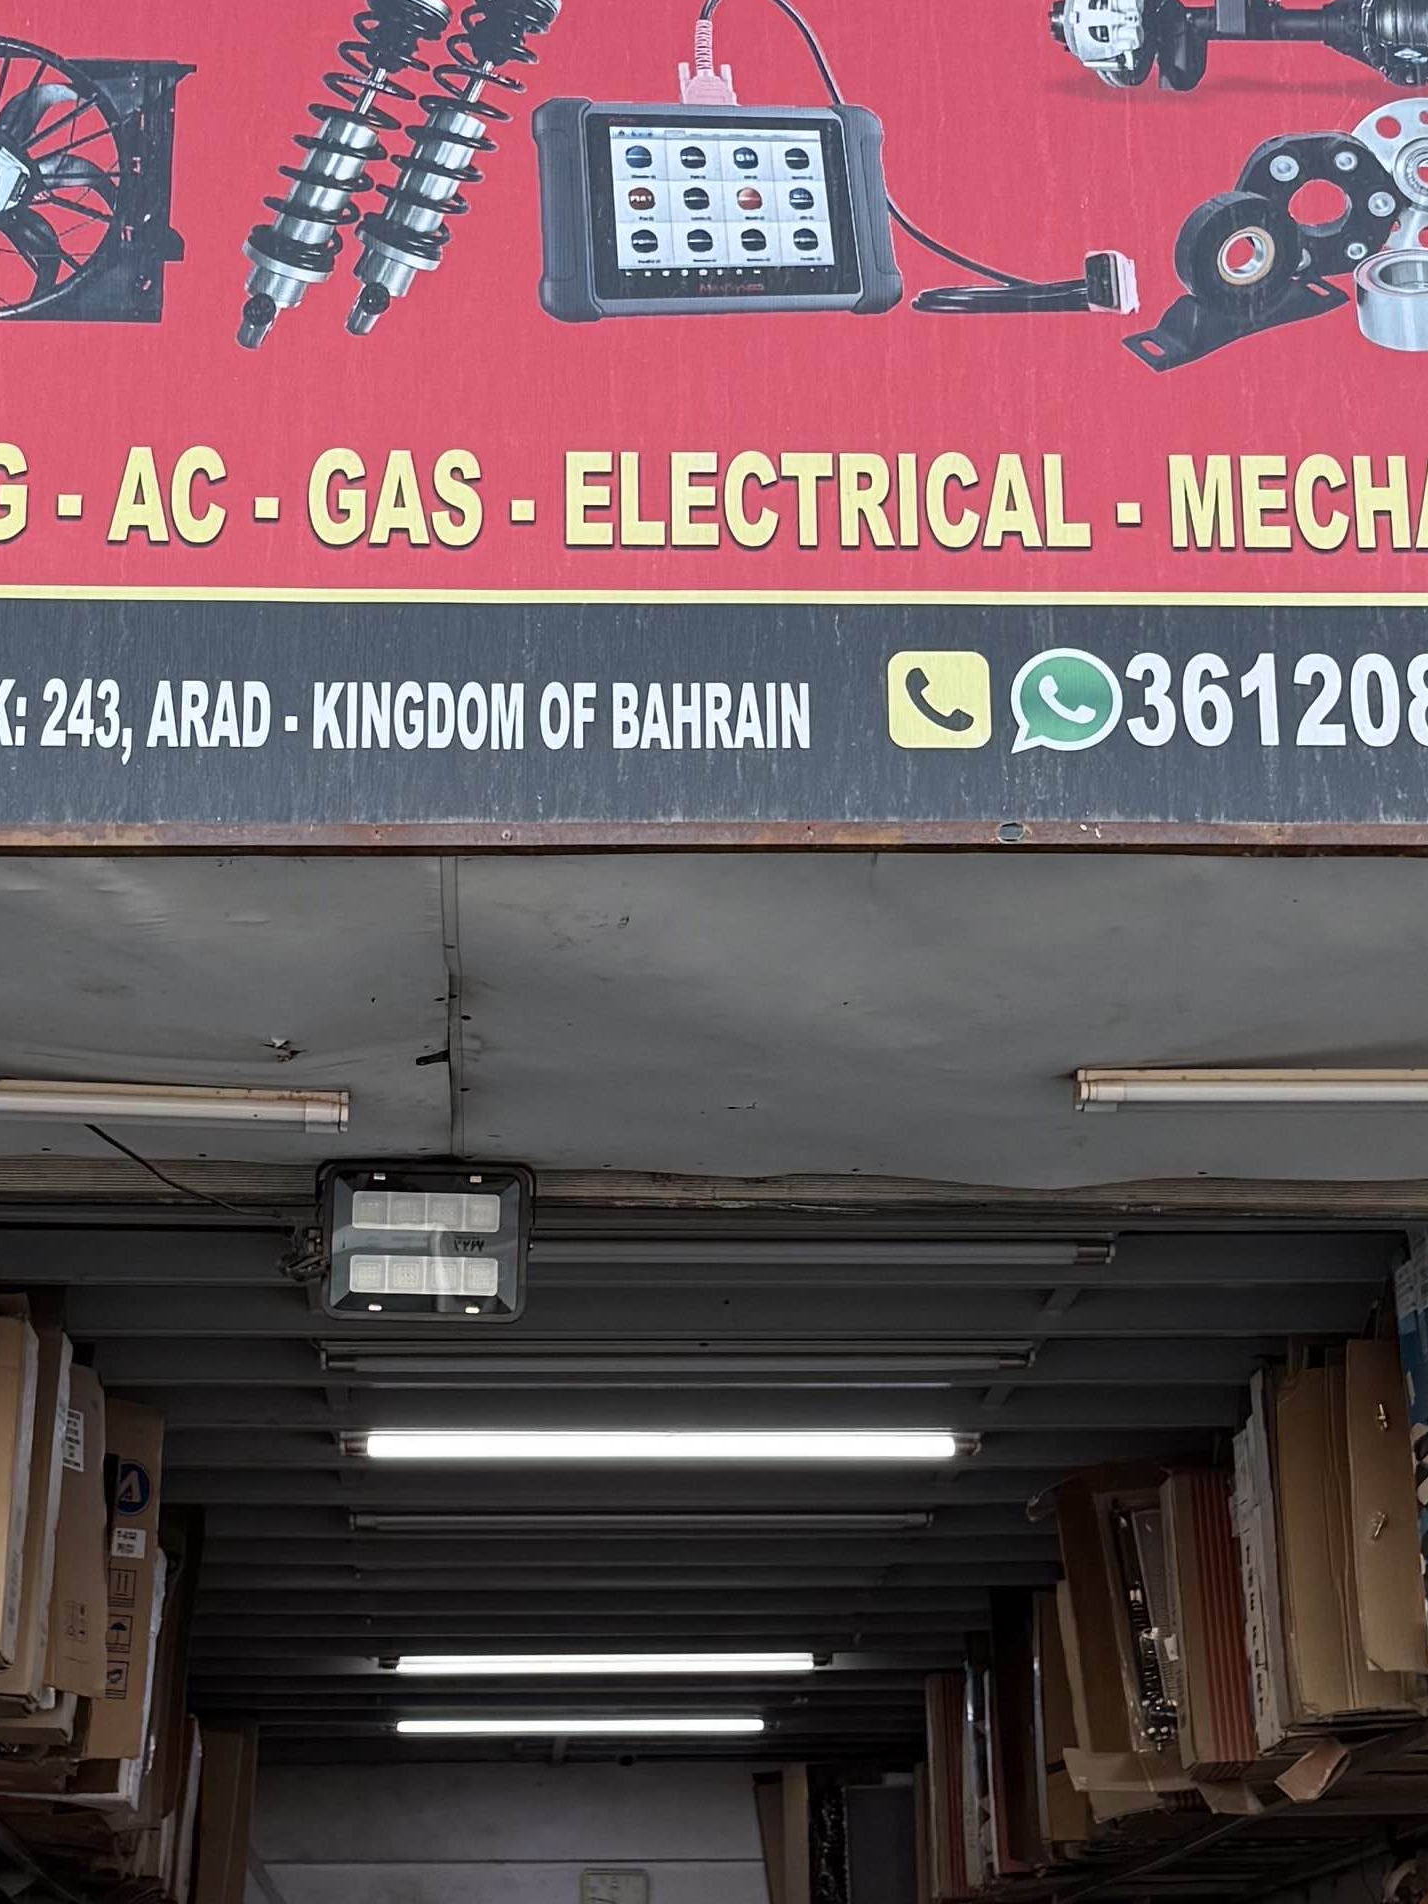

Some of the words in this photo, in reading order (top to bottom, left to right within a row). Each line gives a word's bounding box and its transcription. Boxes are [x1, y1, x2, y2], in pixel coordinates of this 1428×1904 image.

[56, 493, 84, 518] -
[107, 444, 228, 547] AC
[254, 496, 281, 521] -
[306, 447, 484, 551] GAS
[509, 498, 537, 524] -
[563, 449, 1093, 554] ELECTRICAL
[1115, 500, 1143, 526] -
[41, 678, 134, 765] 243,
[145, 680, 273, 750] ARAD
[283, 712, 301, 731] -
[311, 682, 526, 754] KINGDOM
[538, 682, 598, 753] OF
[610, 682, 813, 752] BAHRAIN
